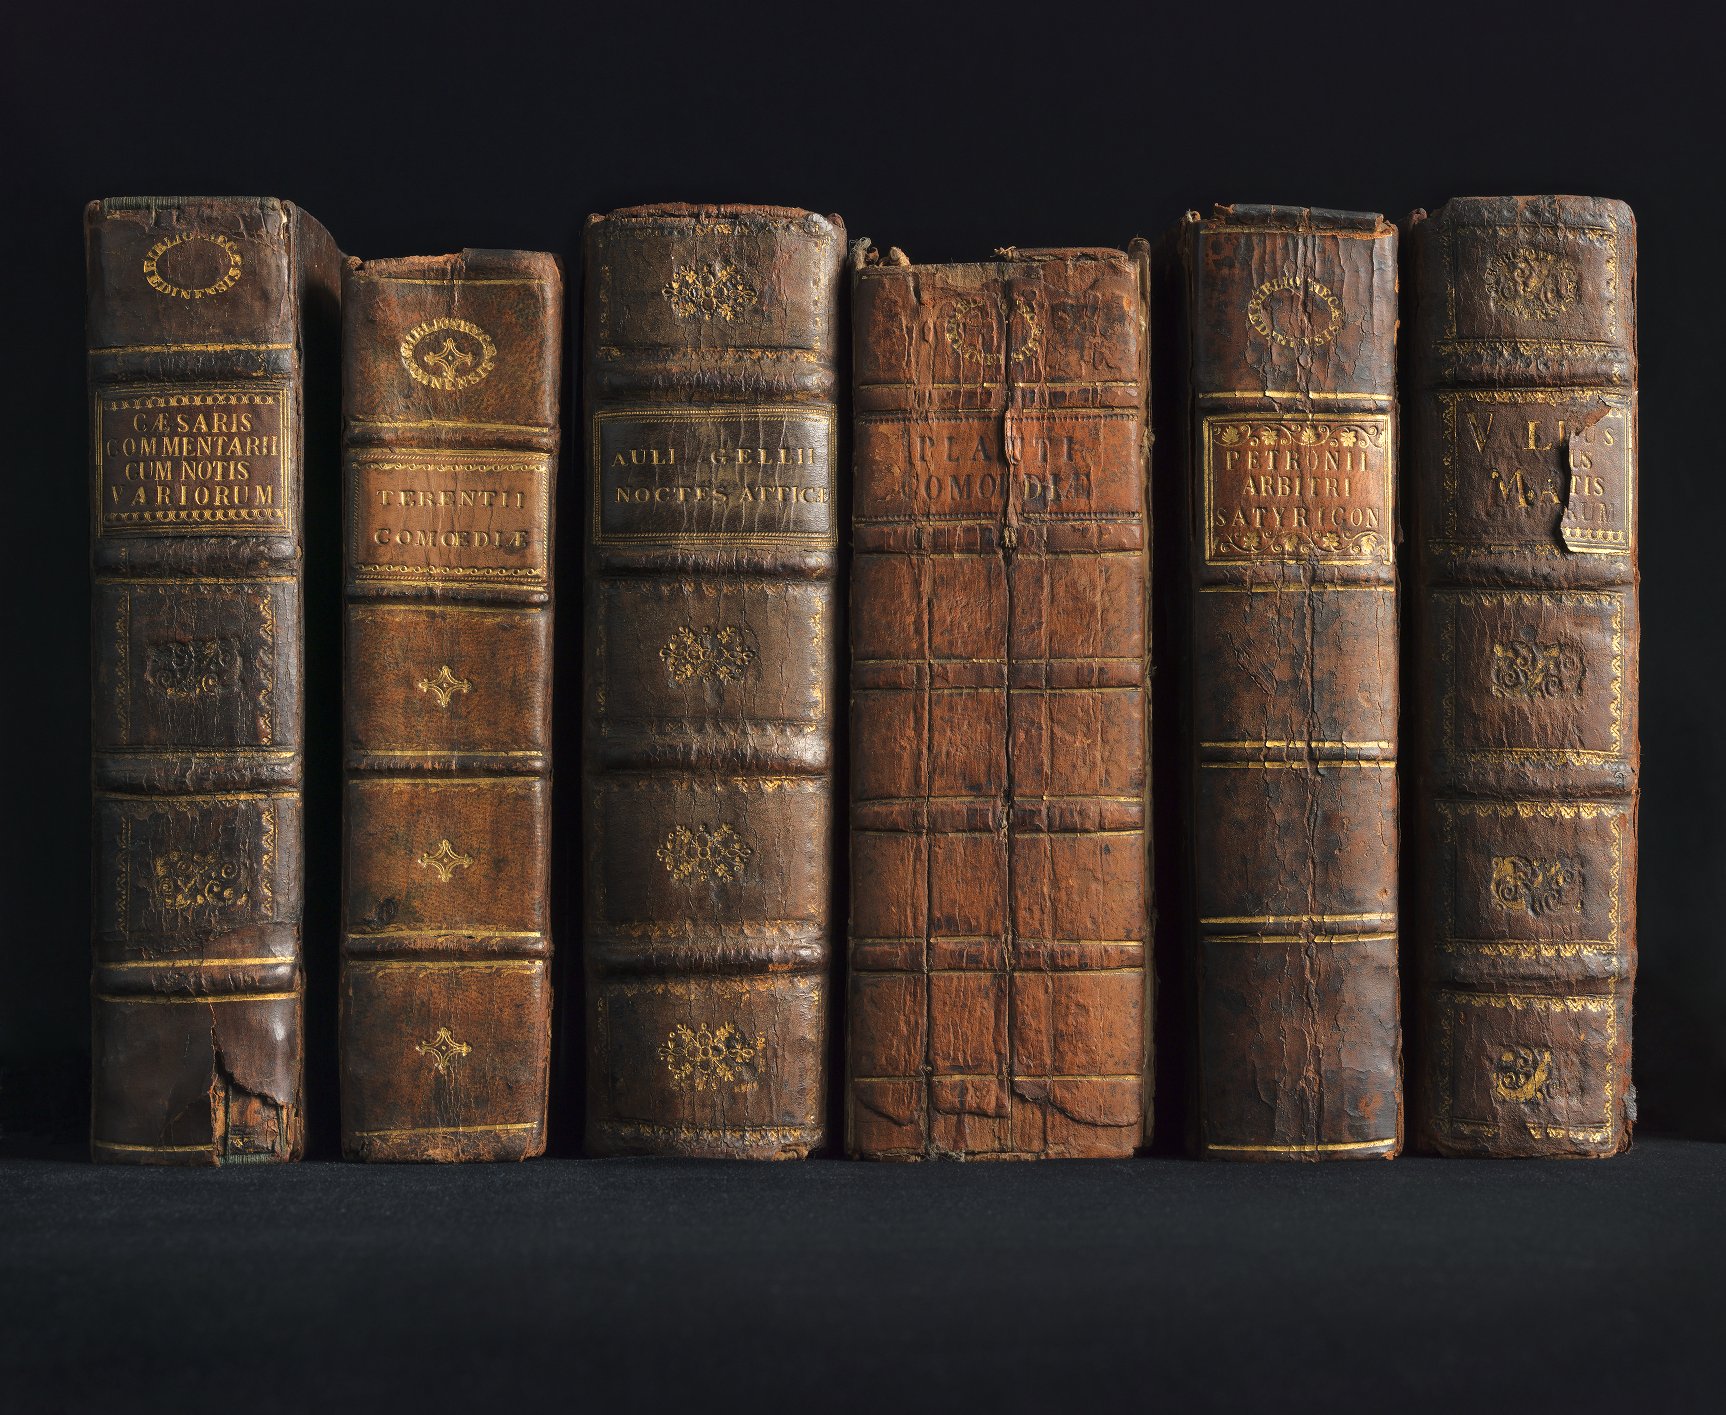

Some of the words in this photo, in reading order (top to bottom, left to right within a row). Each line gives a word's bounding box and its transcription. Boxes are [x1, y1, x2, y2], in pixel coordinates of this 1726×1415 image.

[133, 412, 253, 433] CÆSARIS
[106, 435, 279, 457] COMMENTARII
[611, 447, 677, 467] AULI
[711, 447, 816, 466] GELLII
[1225, 449, 1369, 473] PETRONII
[125, 460, 174, 481] CUM
[180, 460, 251, 481] NOTIS
[111, 484, 274, 506] VARIORUM
[615, 486, 730, 503] NOCTES
[1242, 475, 1352, 498] ARBITRI
[376, 489, 526, 509] TERENTII
[1215, 506, 1381, 529] SATYRICON
